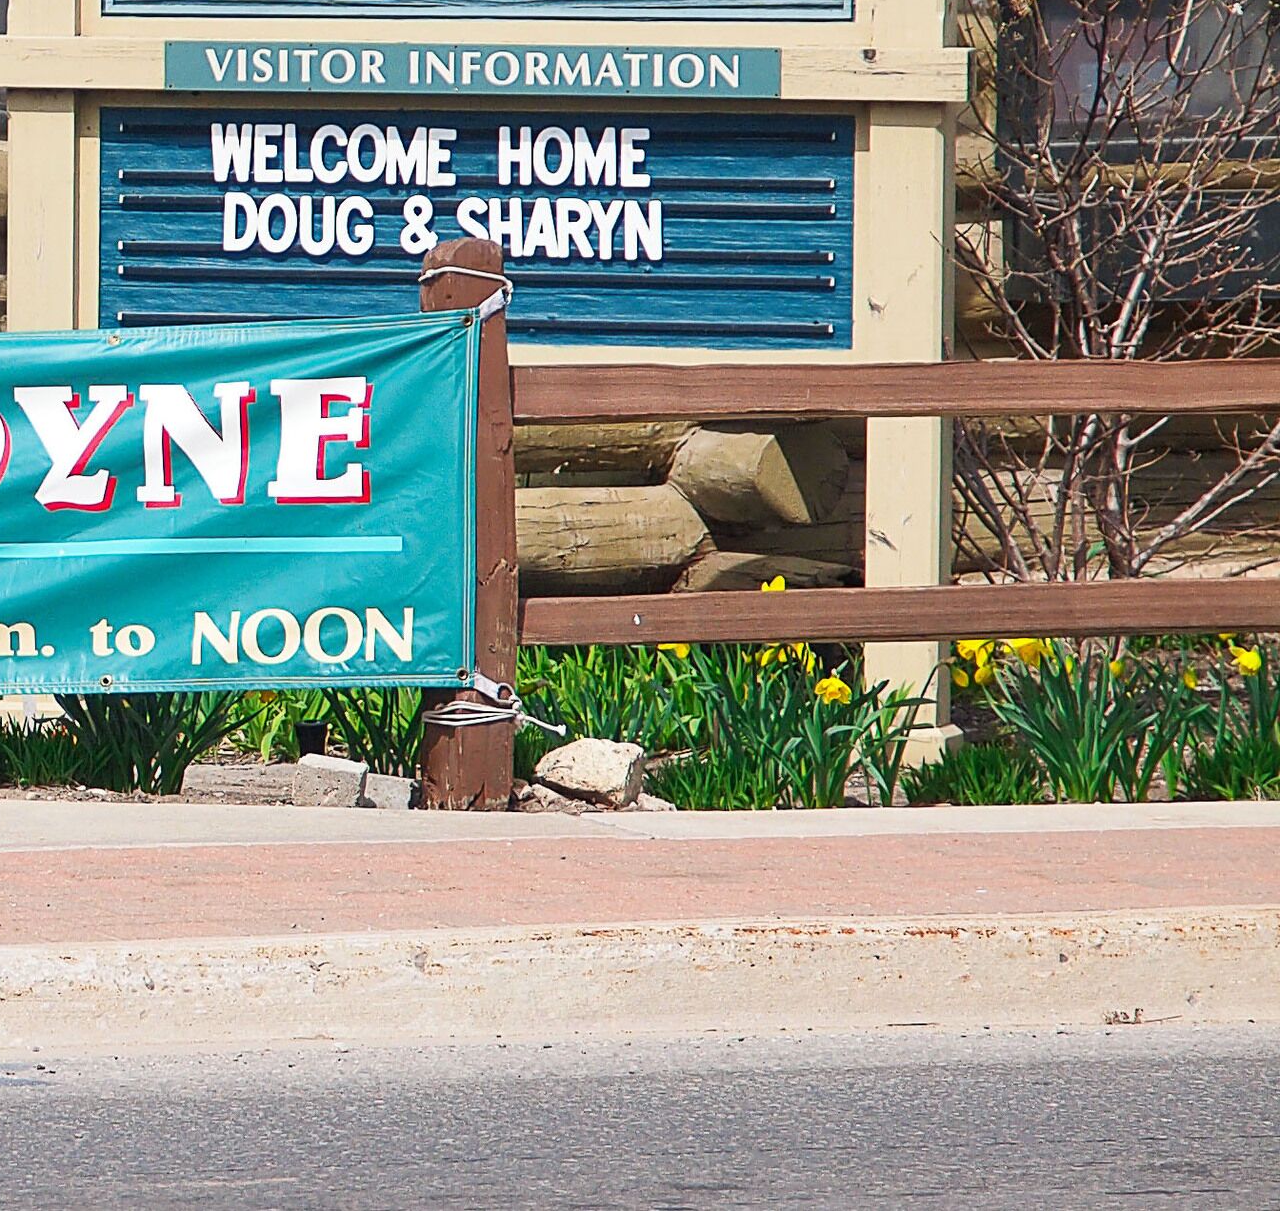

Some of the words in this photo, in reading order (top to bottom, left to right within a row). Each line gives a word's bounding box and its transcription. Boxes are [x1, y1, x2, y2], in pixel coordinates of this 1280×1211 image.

[205, 48, 386, 85] VISITOR
[408, 50, 741, 88] INFORMATION
[210, 123, 457, 188] WELCOME
[498, 126, 651, 188] HOME
[223, 192, 374, 256] DOUG
[400, 194, 439, 255] &
[456, 196, 663, 261] SHARYN
[91, 618, 156, 657] to
[191, 607, 414, 665] NOON
